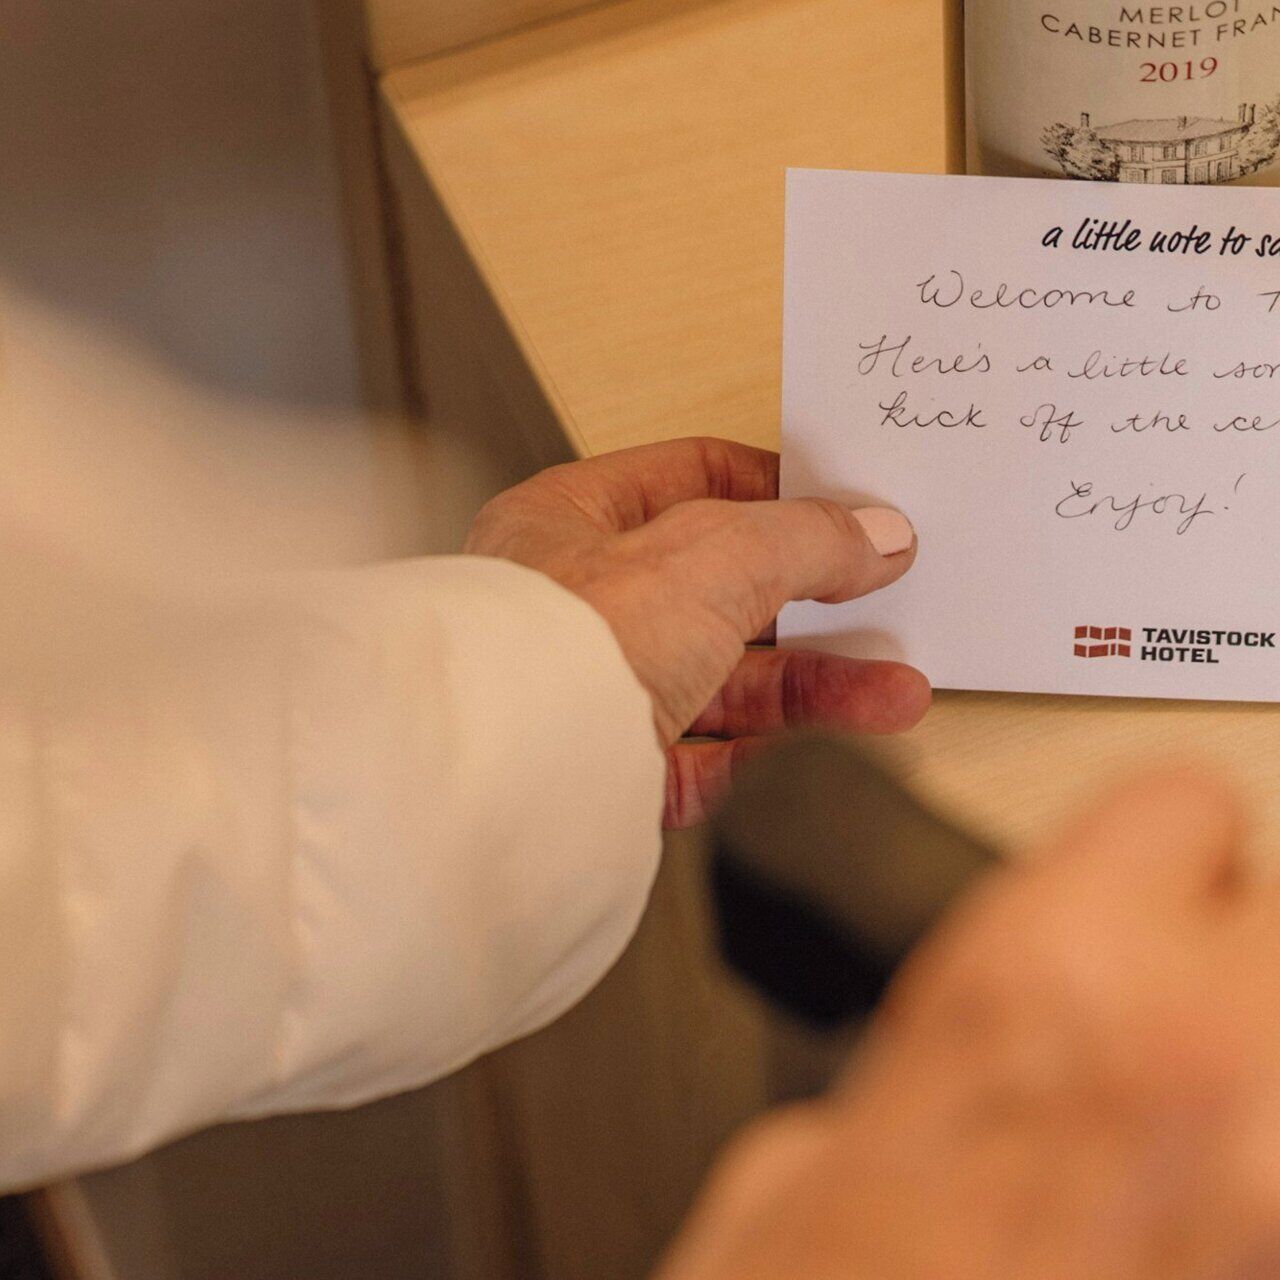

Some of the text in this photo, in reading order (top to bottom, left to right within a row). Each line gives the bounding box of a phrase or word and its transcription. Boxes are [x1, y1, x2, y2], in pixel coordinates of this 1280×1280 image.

[1040, 14, 1201, 49] CABERNET
[1139, 56, 1219, 83] 2019
[1042, 225, 1062, 248] a
[1072, 218, 1141, 252] little
[1150, 224, 1211, 255] note
[1219, 226, 1251, 256] to
[916, 270, 1136, 309] Welcome
[1167, 285, 1221, 312] to
[857, 335, 992, 377] Here's
[1016, 354, 1053, 373] a
[1067, 351, 1189, 380] little
[878, 391, 987, 429] kick
[1020, 403, 1084, 444] off
[1110, 409, 1191, 433] the
[1055, 473, 1248, 536] Enjoy!
[1140, 646, 1219, 663] HOTEL
[1142, 627, 1276, 647] TAVISTOCK
